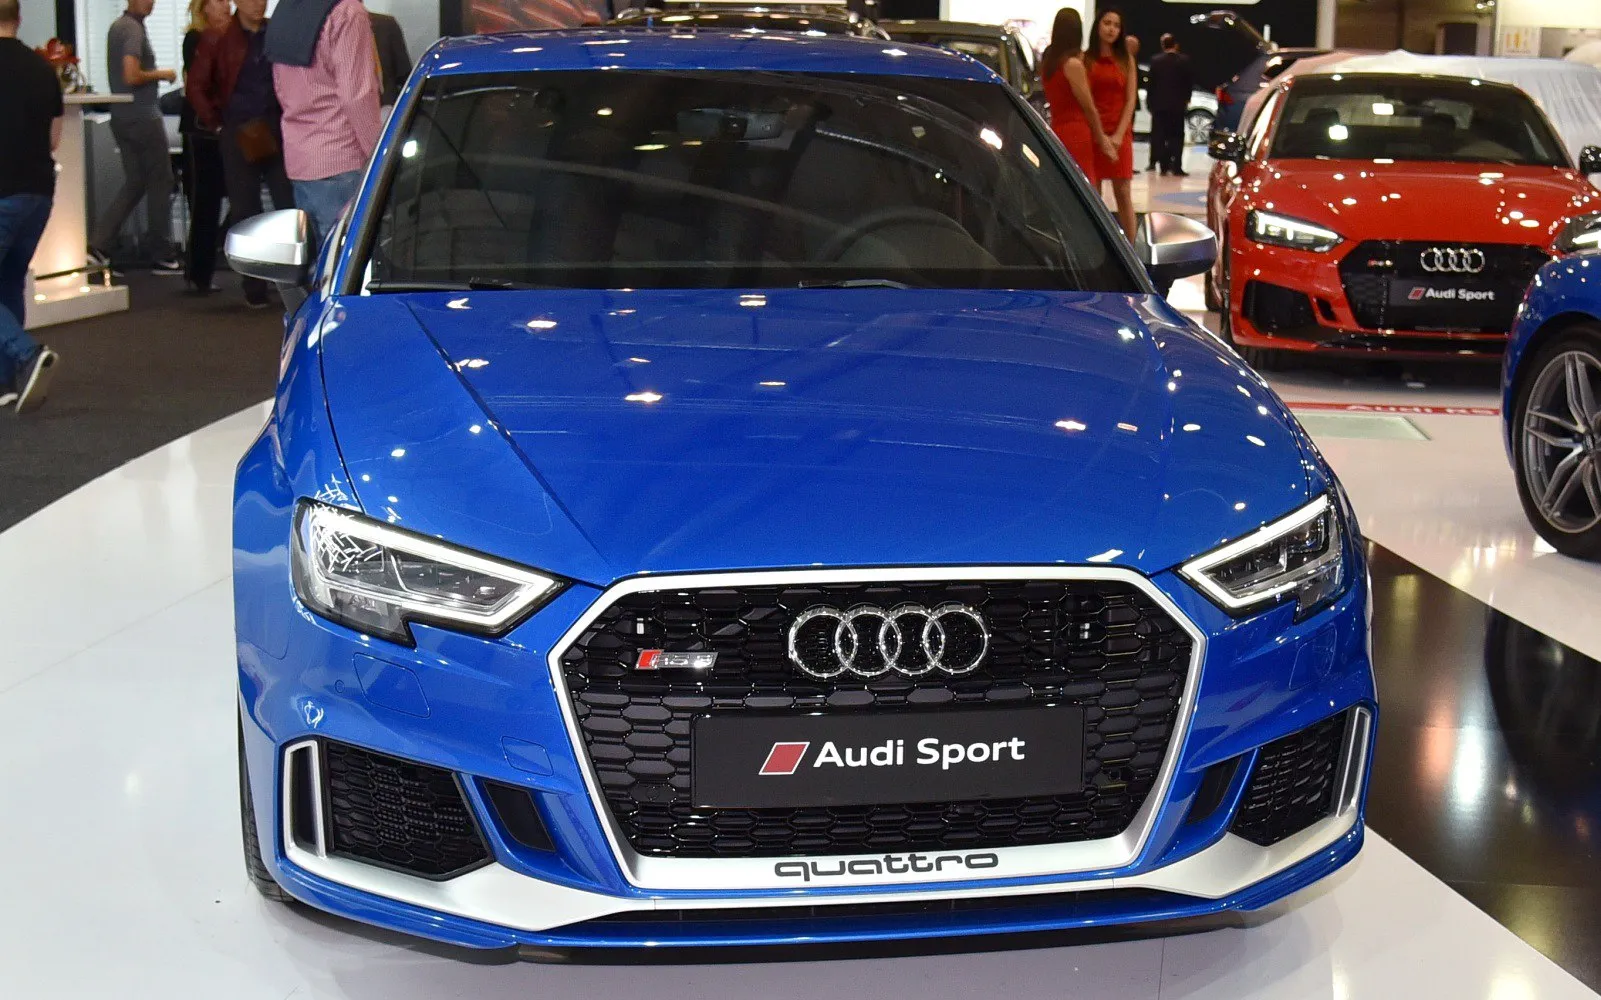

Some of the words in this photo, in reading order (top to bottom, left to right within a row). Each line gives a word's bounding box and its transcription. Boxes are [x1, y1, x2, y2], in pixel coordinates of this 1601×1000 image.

[1425, 287, 1455, 299] Audi
[1458, 288, 1495, 301] Sport
[813, 739, 904, 768] Audi
[916, 737, 1026, 770] Sport
[774, 852, 999, 882] quattro
